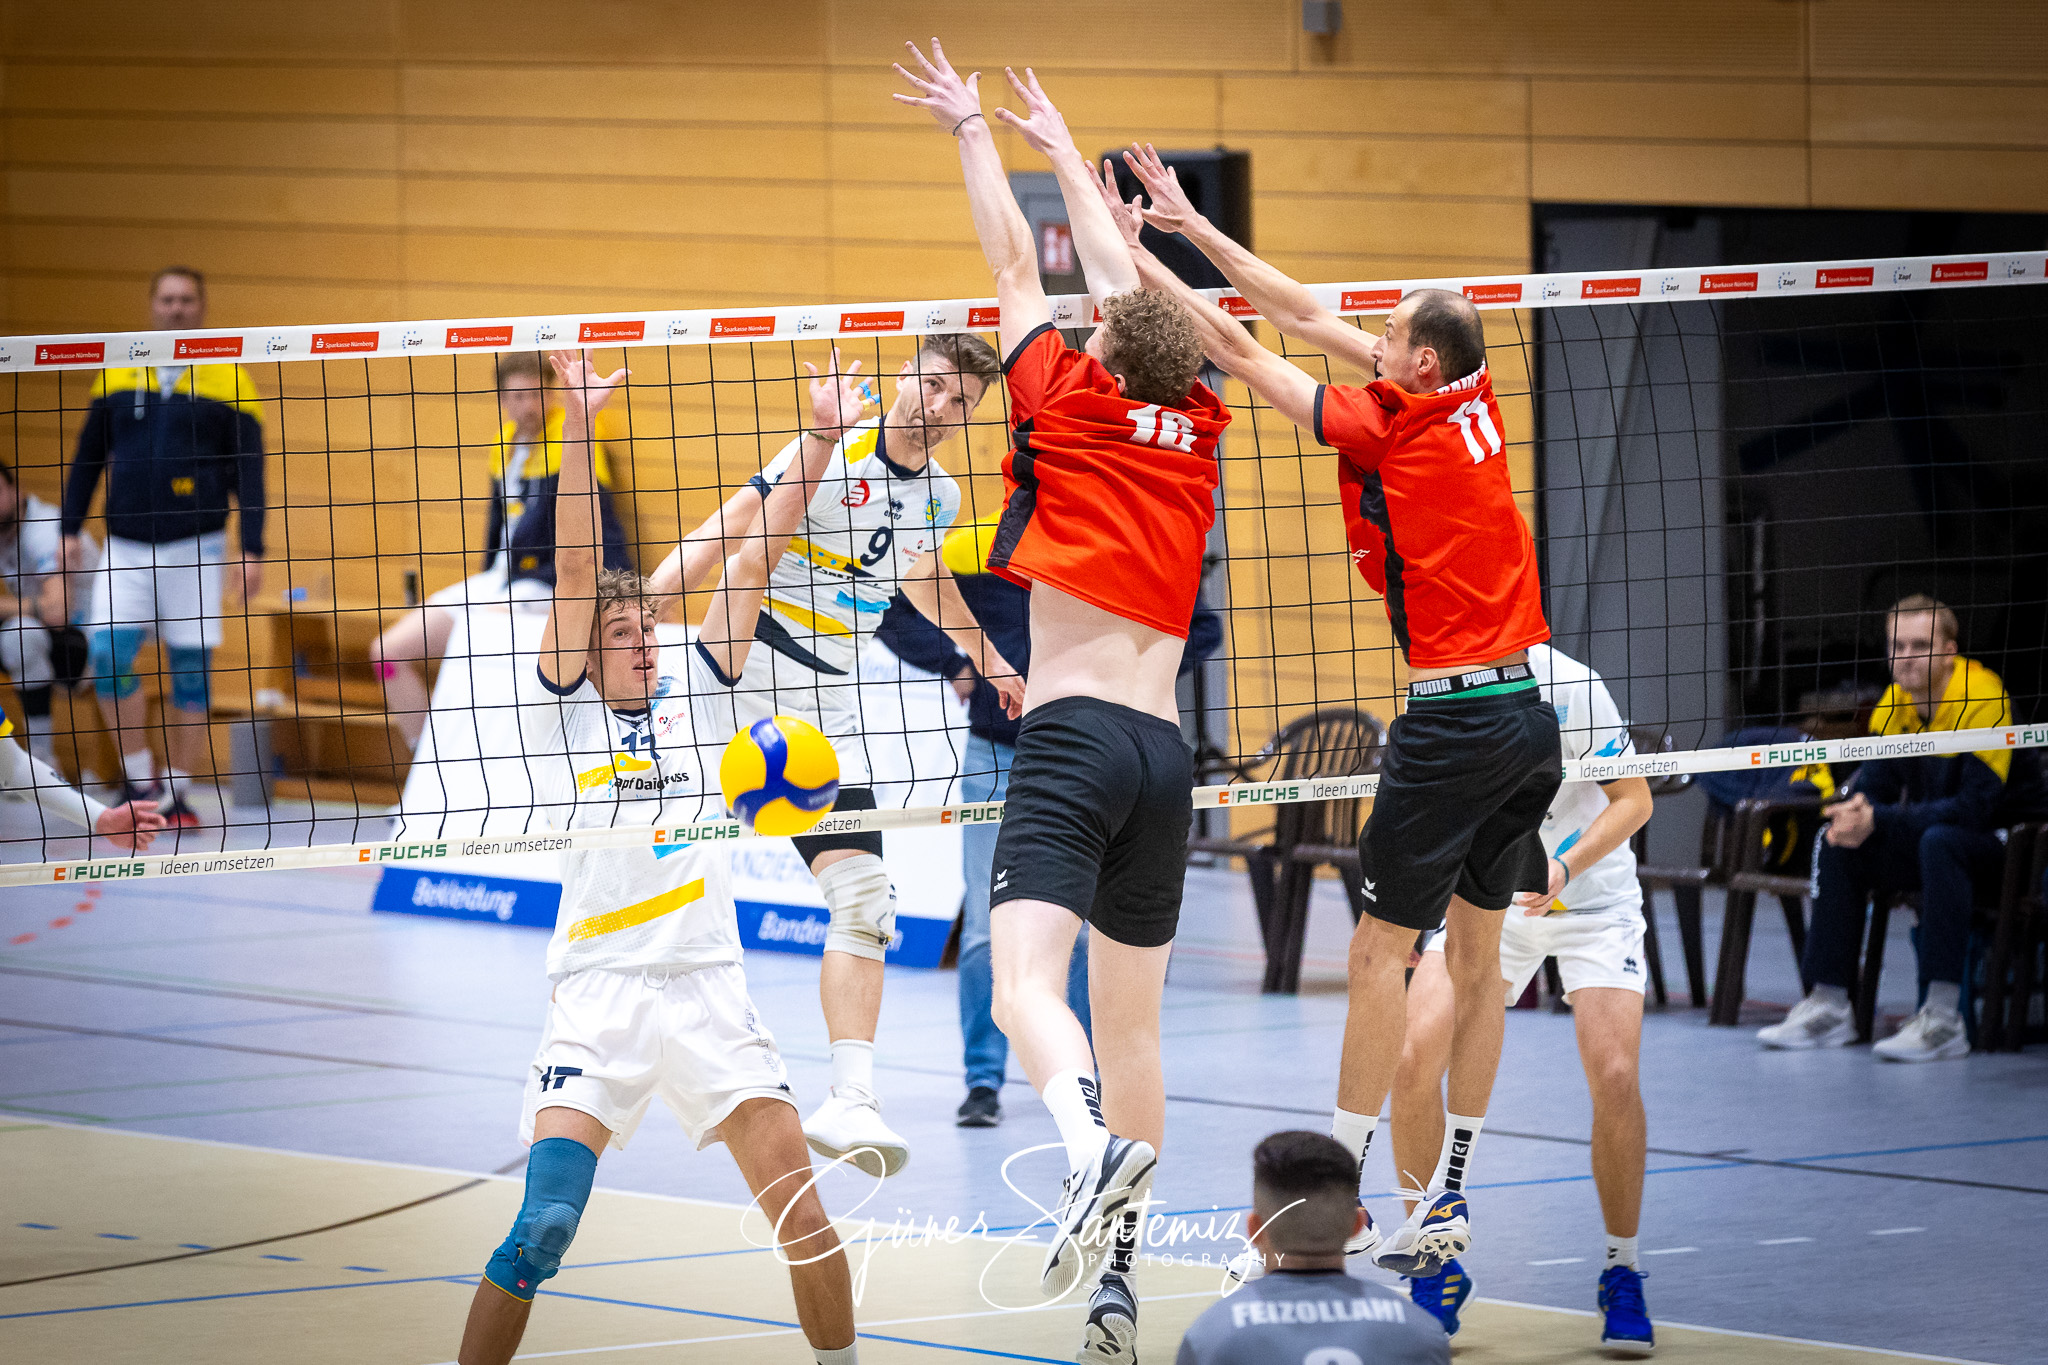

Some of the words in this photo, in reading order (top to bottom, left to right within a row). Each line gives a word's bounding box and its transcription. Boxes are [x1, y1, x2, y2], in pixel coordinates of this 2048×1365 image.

[2011, 267, 2026, 275] Zapf
[1782, 279, 1796, 287] Zapf
[1547, 290, 1561, 298] Zapf
[1616, 285, 1637, 293] Nürnberg
[1353, 299, 1376, 307] Sparkasse
[1376, 297, 1398, 306] Nürnberg
[1474, 294, 1496, 302] Sparkasse
[1496, 291, 1518, 301] Nürnberg
[1057, 312, 1073, 320] Zapf
[802, 323, 818, 331] Zapf
[853, 320, 877, 329] Sparkasse
[877, 318, 900, 328] Nürnberg
[931, 318, 946, 326] Zapf
[592, 331, 616, 339] Sparkasse
[617, 328, 641, 338] Nürnberg
[672, 328, 688, 336] Zapf
[723, 325, 747, 334] Sparkasse
[748, 323, 771, 333] Nürnberg
[460, 335, 484, 344] Sparkasse
[485, 333, 509, 343] Nürnberg
[541, 333, 556, 341] Zapf
[325, 342, 350, 351] Sparkasse
[350, 340, 375, 350] Nürnberg
[407, 339, 423, 347] Zapf
[134, 350, 150, 358] Zapf
[188, 349, 214, 358] Sparkasse
[214, 347, 238, 357] Nürnberg
[272, 345, 288, 353] Zapf
[50, 353, 75, 362] Sparkasse
[75, 351, 100, 360] Nürnberg
[1446, 390, 1502, 465] 11
[860, 526, 893, 567] 9
[1502, 664, 1529, 680] PUMA
[1461, 668, 1500, 688] PUMA
[1412, 678, 1452, 696] PUMA
[1768, 747, 1827, 763] FUCHS
[1839, 743, 1873, 760] Ideen
[1876, 740, 1935, 756] umsetzen
[1579, 763, 1614, 779] Ideen
[1617, 759, 1678, 776] umsetzen
[1237, 786, 1299, 803] FUCHS
[1312, 783, 1348, 798] Ideen
[674, 825, 740, 841] FUCHS
[805, 816, 862, 833] setzen
[379, 844, 447, 861] FUCHS
[461, 840, 500, 855] Ideen
[504, 837, 573, 853] umsetzen
[75, 863, 145, 880] FUCHS
[160, 860, 200, 875] Ideen
[204, 856, 275, 872] umsetzen
[1231, 1298, 1407, 1329] FEIZOLLAHI
